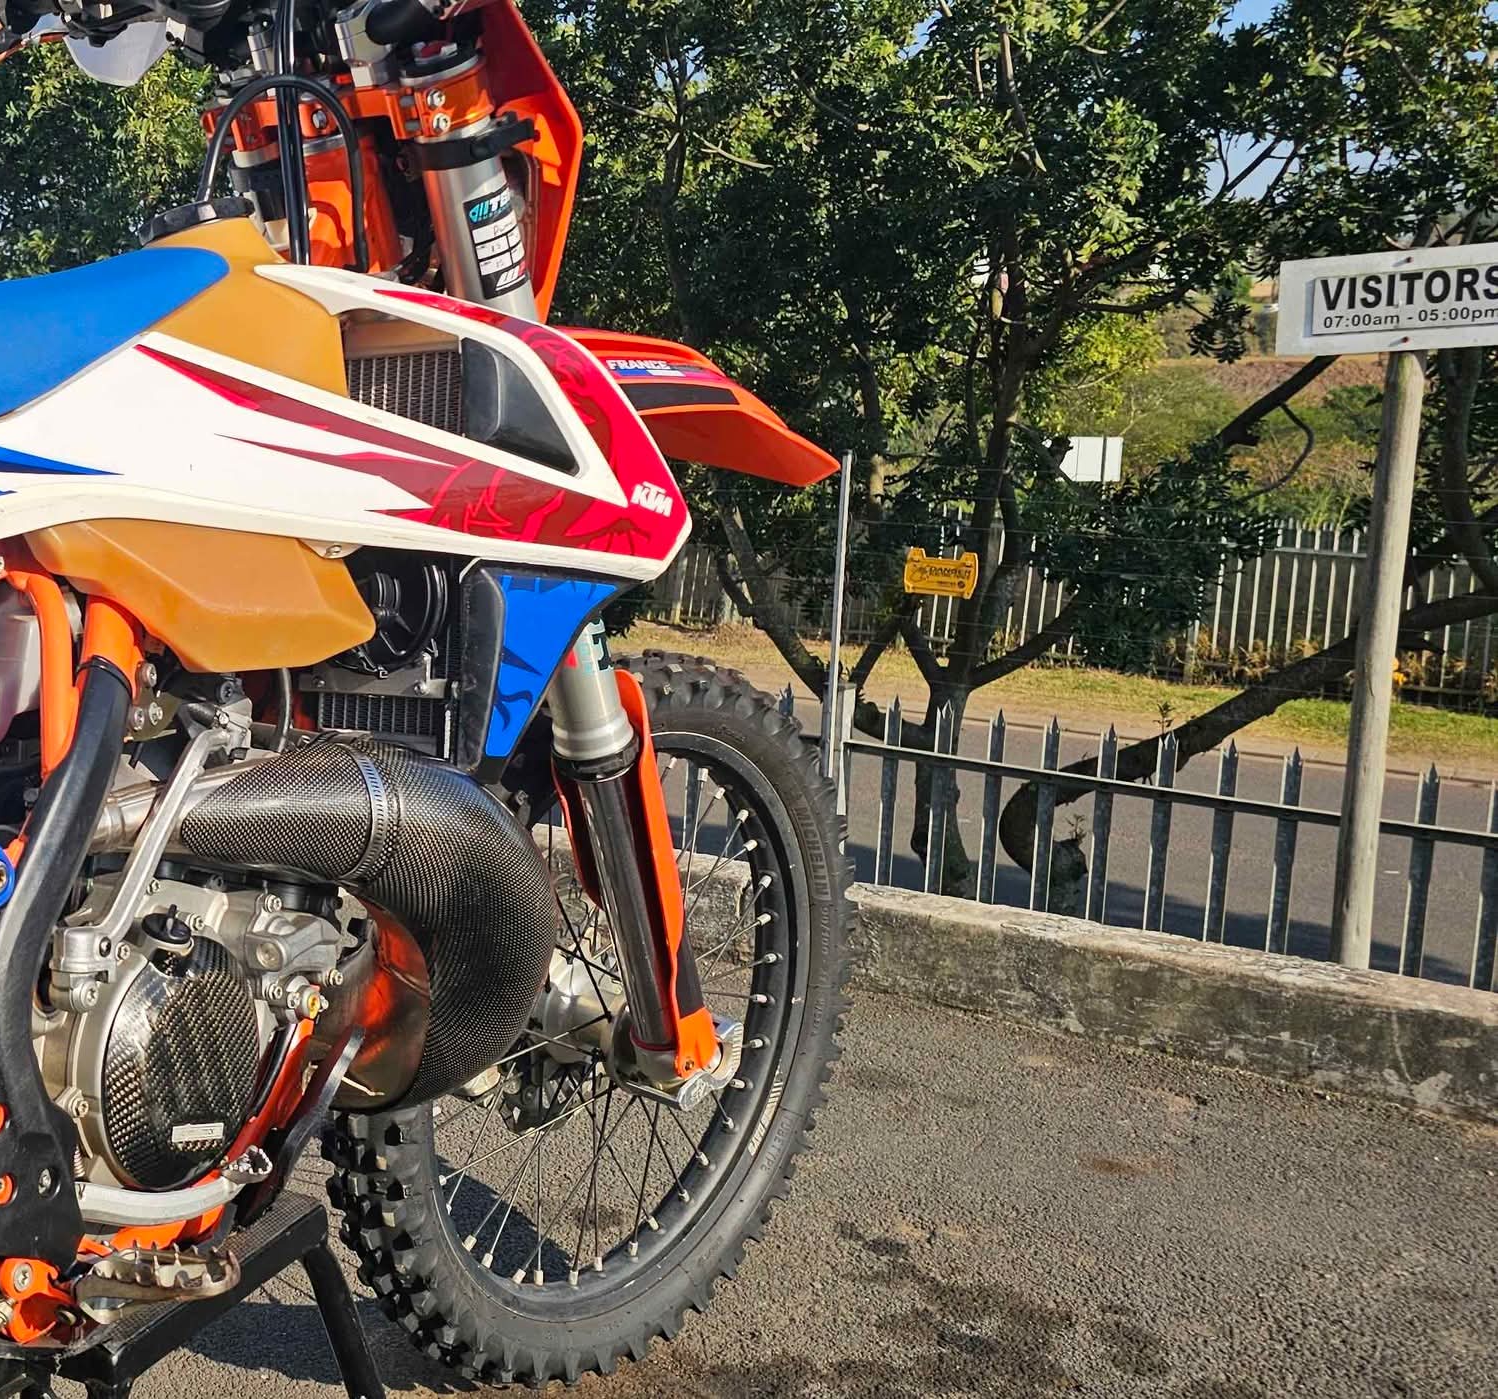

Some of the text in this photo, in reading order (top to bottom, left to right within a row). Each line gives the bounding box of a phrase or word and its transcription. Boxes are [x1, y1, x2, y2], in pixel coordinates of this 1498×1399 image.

[1320, 265, 1498, 310] VISITORS
[1323, 313, 1400, 329] 07:00am
[1418, 307, 1498, 323] 05:00pm
[605, 359, 671, 370] FRANCE
[630, 480, 674, 517] KTM
[793, 806, 830, 898] MICHELIN
